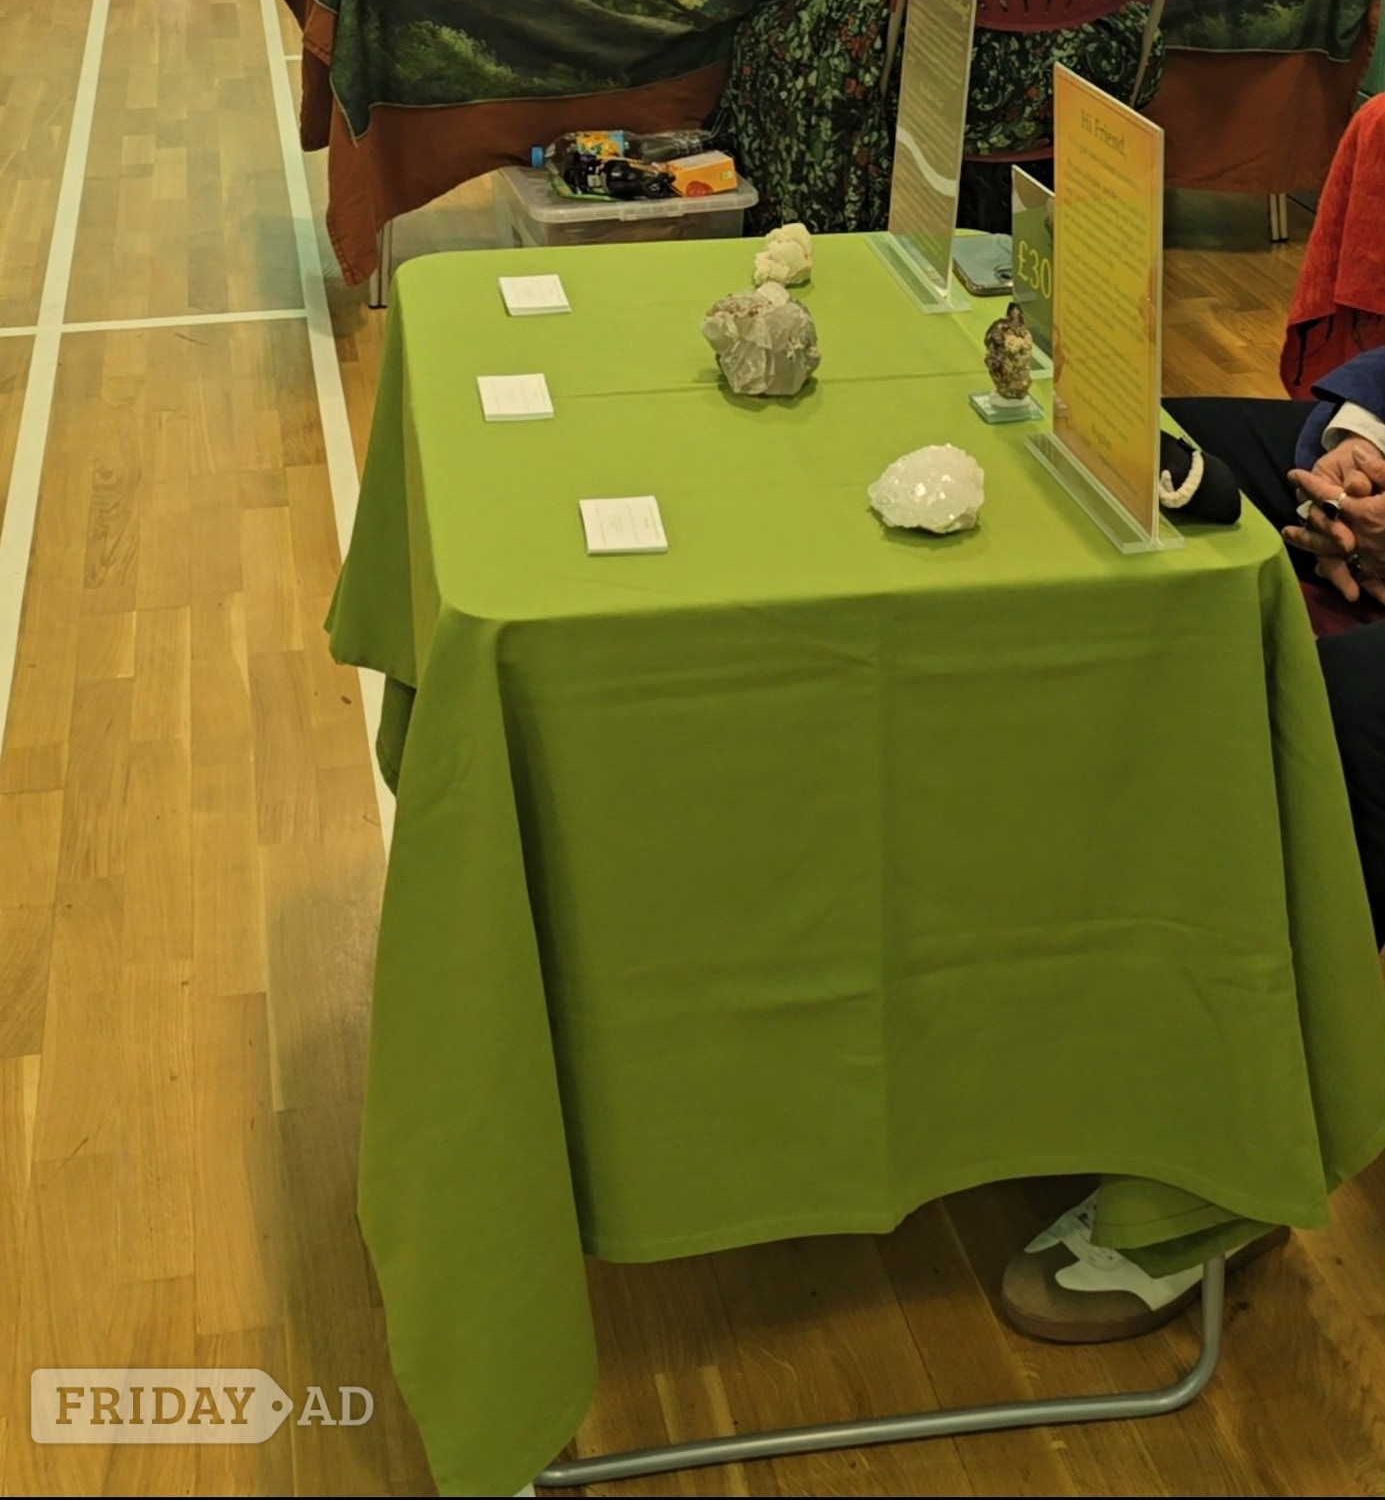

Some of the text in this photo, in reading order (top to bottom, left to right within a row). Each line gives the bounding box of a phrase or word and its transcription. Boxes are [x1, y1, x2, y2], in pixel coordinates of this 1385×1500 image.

[1081, 109, 1127, 161] Hi Friend,
[1017, 240, 1052, 299] £30
